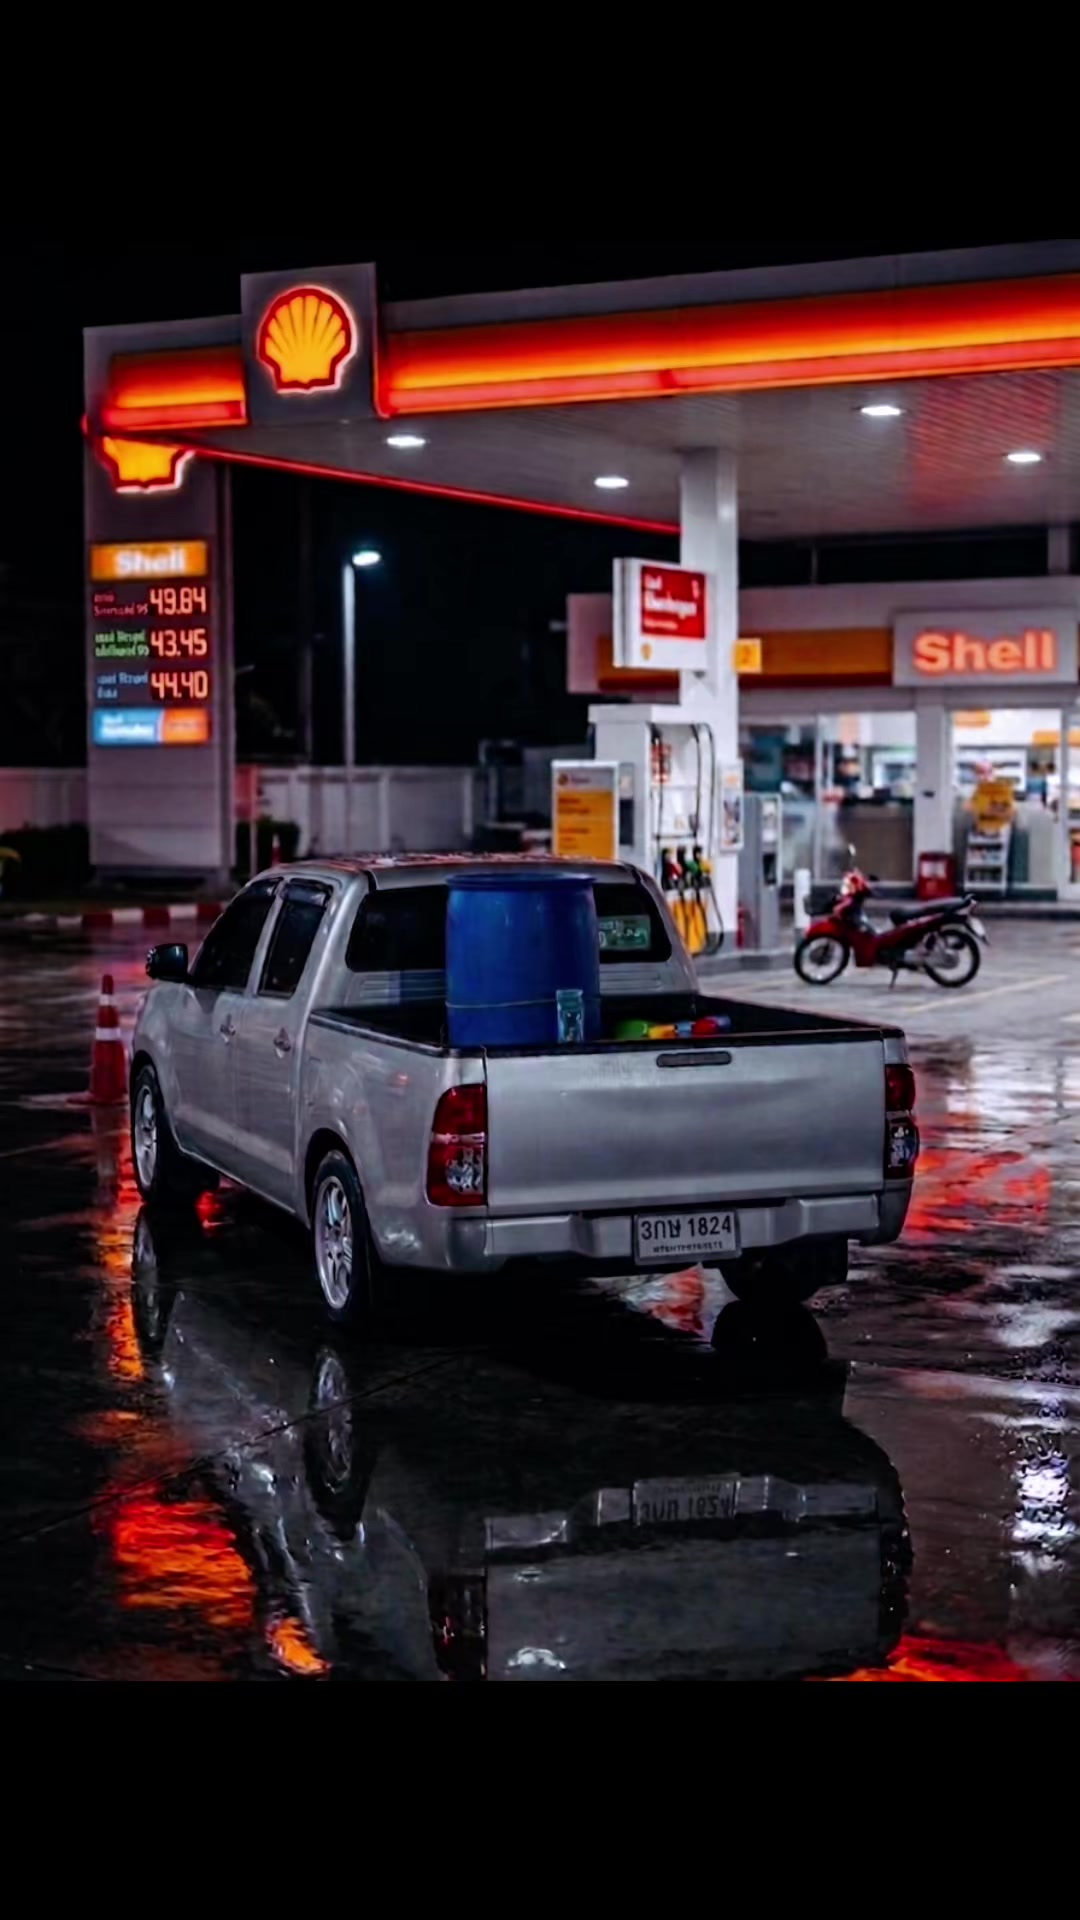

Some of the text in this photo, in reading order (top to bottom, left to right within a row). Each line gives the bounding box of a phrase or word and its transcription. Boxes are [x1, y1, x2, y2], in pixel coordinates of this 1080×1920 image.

[115, 547, 186, 578] Shell
[149, 586, 207, 615] 49.84
[150, 628, 208, 657] 43.45
[914, 629, 1055, 674] Shell
[151, 670, 208, 699] 44.40
[688, 1215, 732, 1237] 1824
